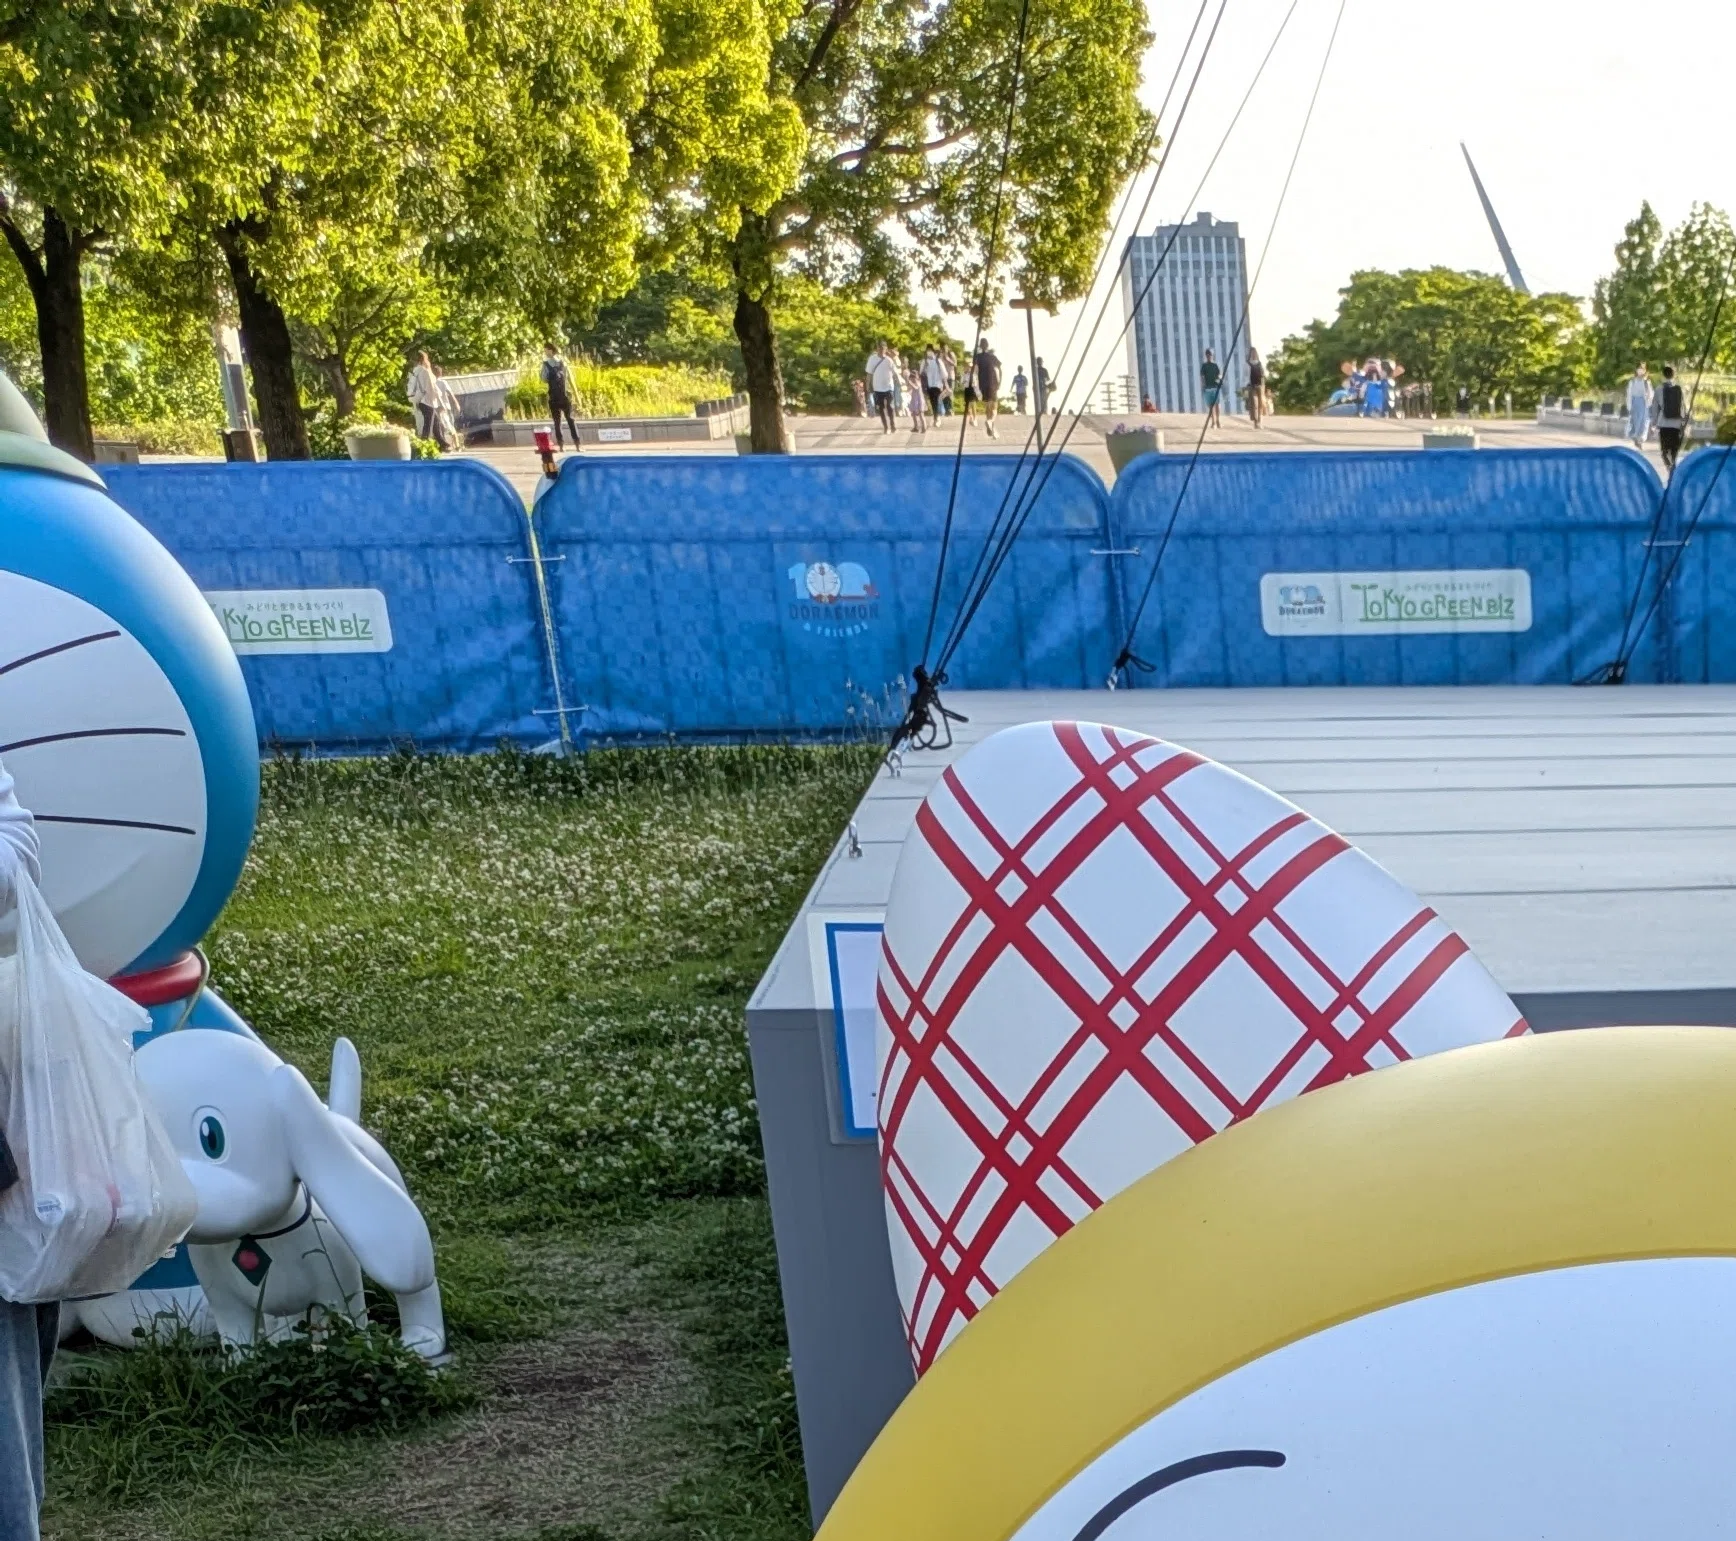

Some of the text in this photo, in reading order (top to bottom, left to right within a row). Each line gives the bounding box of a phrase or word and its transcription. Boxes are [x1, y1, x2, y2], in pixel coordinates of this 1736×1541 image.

[788, 604, 879, 620] DORAEMON
[1351, 584, 1514, 621] TOKYO GREEN BIZ
[222, 608, 372, 640] KYO GREEN BIZ
